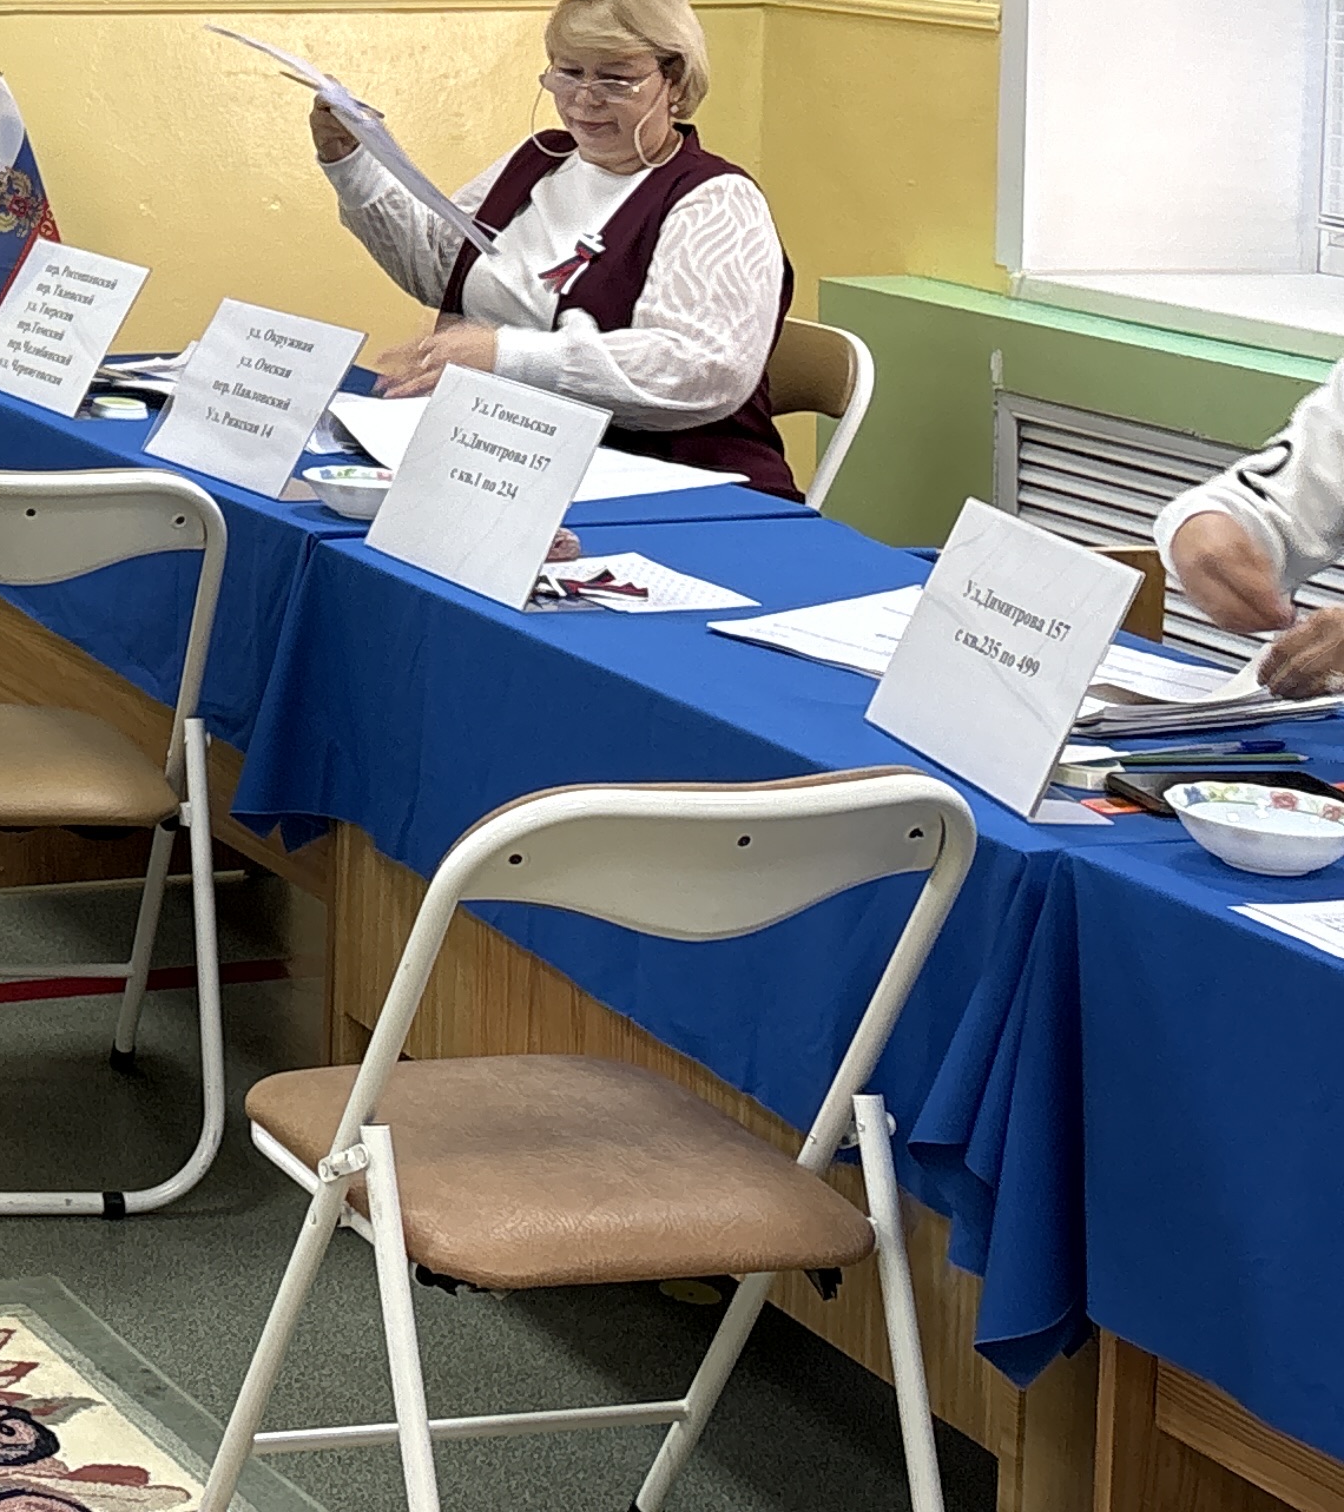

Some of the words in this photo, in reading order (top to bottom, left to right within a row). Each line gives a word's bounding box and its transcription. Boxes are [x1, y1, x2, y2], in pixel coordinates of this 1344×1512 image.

[246, 327, 261, 340] ул.
[263, 328, 314, 353] Окружная
[236, 356, 252, 368] ул.
[254, 357, 293, 378] Омская
[212, 380, 230, 396] пер.
[260, 423, 274, 439] 14
[490, 403, 557, 436] Гомельская
[528, 453, 551, 472] 157
[450, 468, 458, 479] с
[481, 478, 497, 492] по
[496, 480, 519, 500] 234
[1045, 618, 1072, 642] 157
[954, 629, 964, 641] с
[962, 632, 1003, 659] кв.235
[998, 650, 1016, 667] по
[1016, 655, 1040, 678] 499
